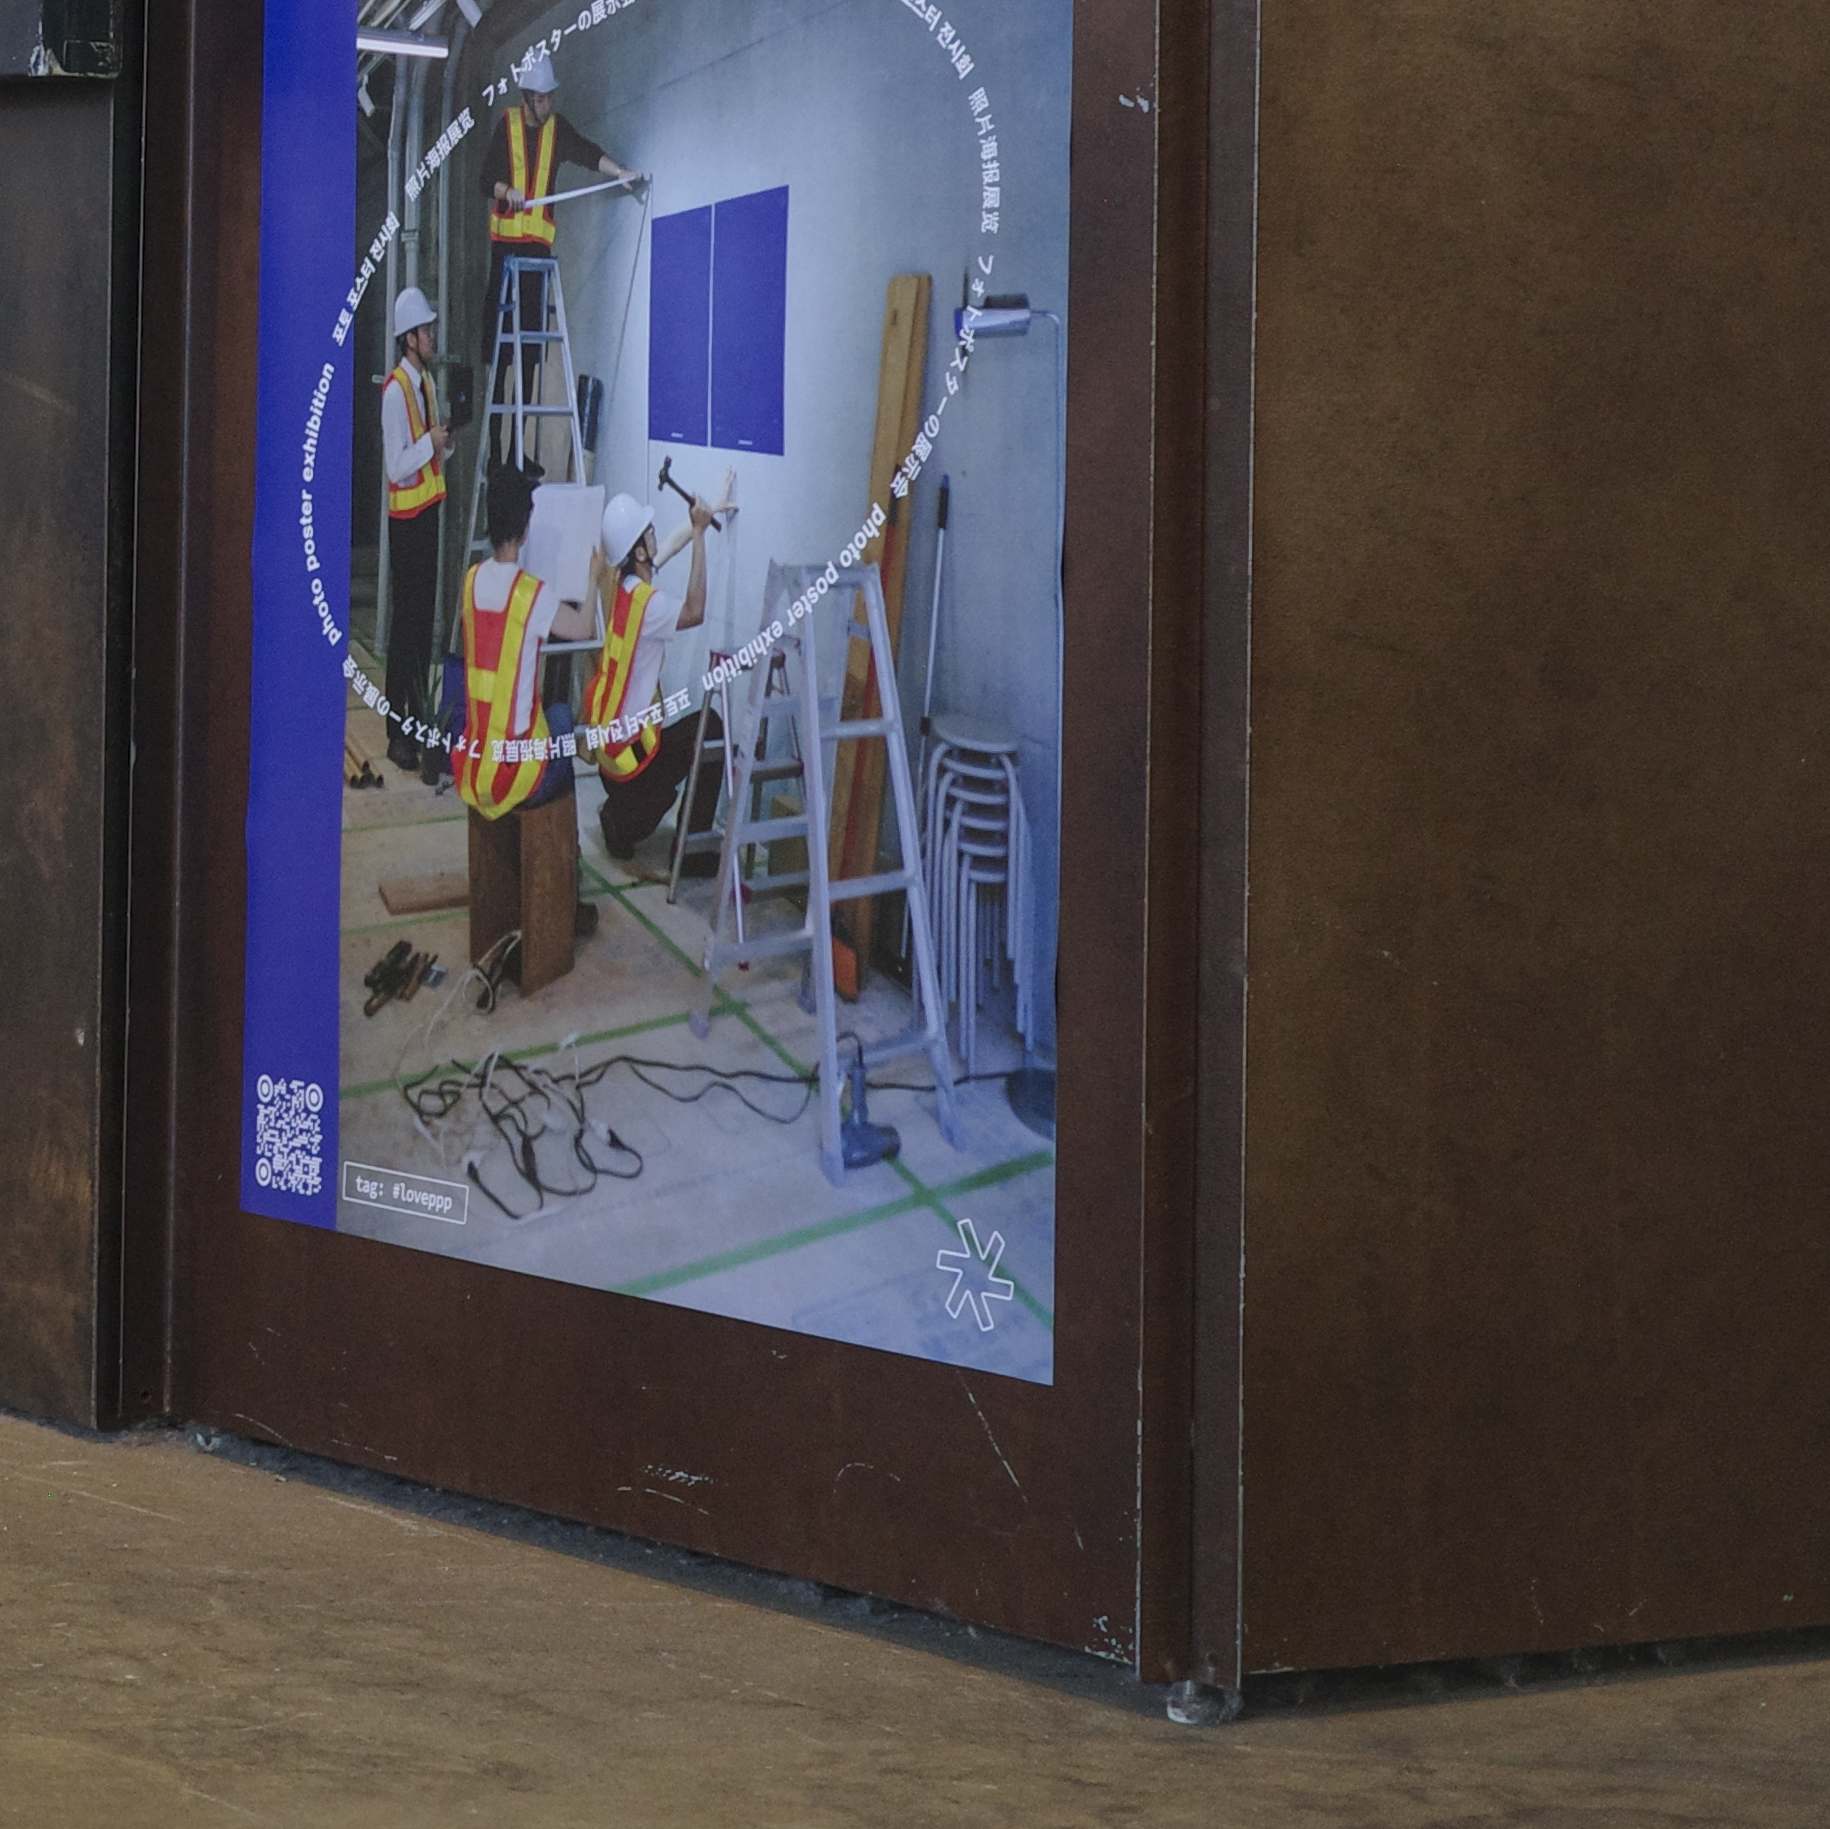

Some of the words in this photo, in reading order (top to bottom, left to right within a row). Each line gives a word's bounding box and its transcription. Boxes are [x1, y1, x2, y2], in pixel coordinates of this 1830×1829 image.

[936, 21, 975, 80] 전시회
[404, 106, 475, 202] 照片海报展览
[967, 86, 1001, 234] 照片海报展览
[332, 307, 354, 347] 포토
[346, 255, 376, 312] 포스터
[369, 210, 401, 262] 전시회
[302, 362, 335, 482] exhibition
[299, 489, 321, 572] poster
[840, 502, 887, 568] photo
[311, 577, 342, 646] photo
[787, 561, 840, 627] poster
[701, 620, 785, 690] exhibition
[355, 1174, 384, 1200] tag:
[393, 1182, 453, 1213] #loveppp
